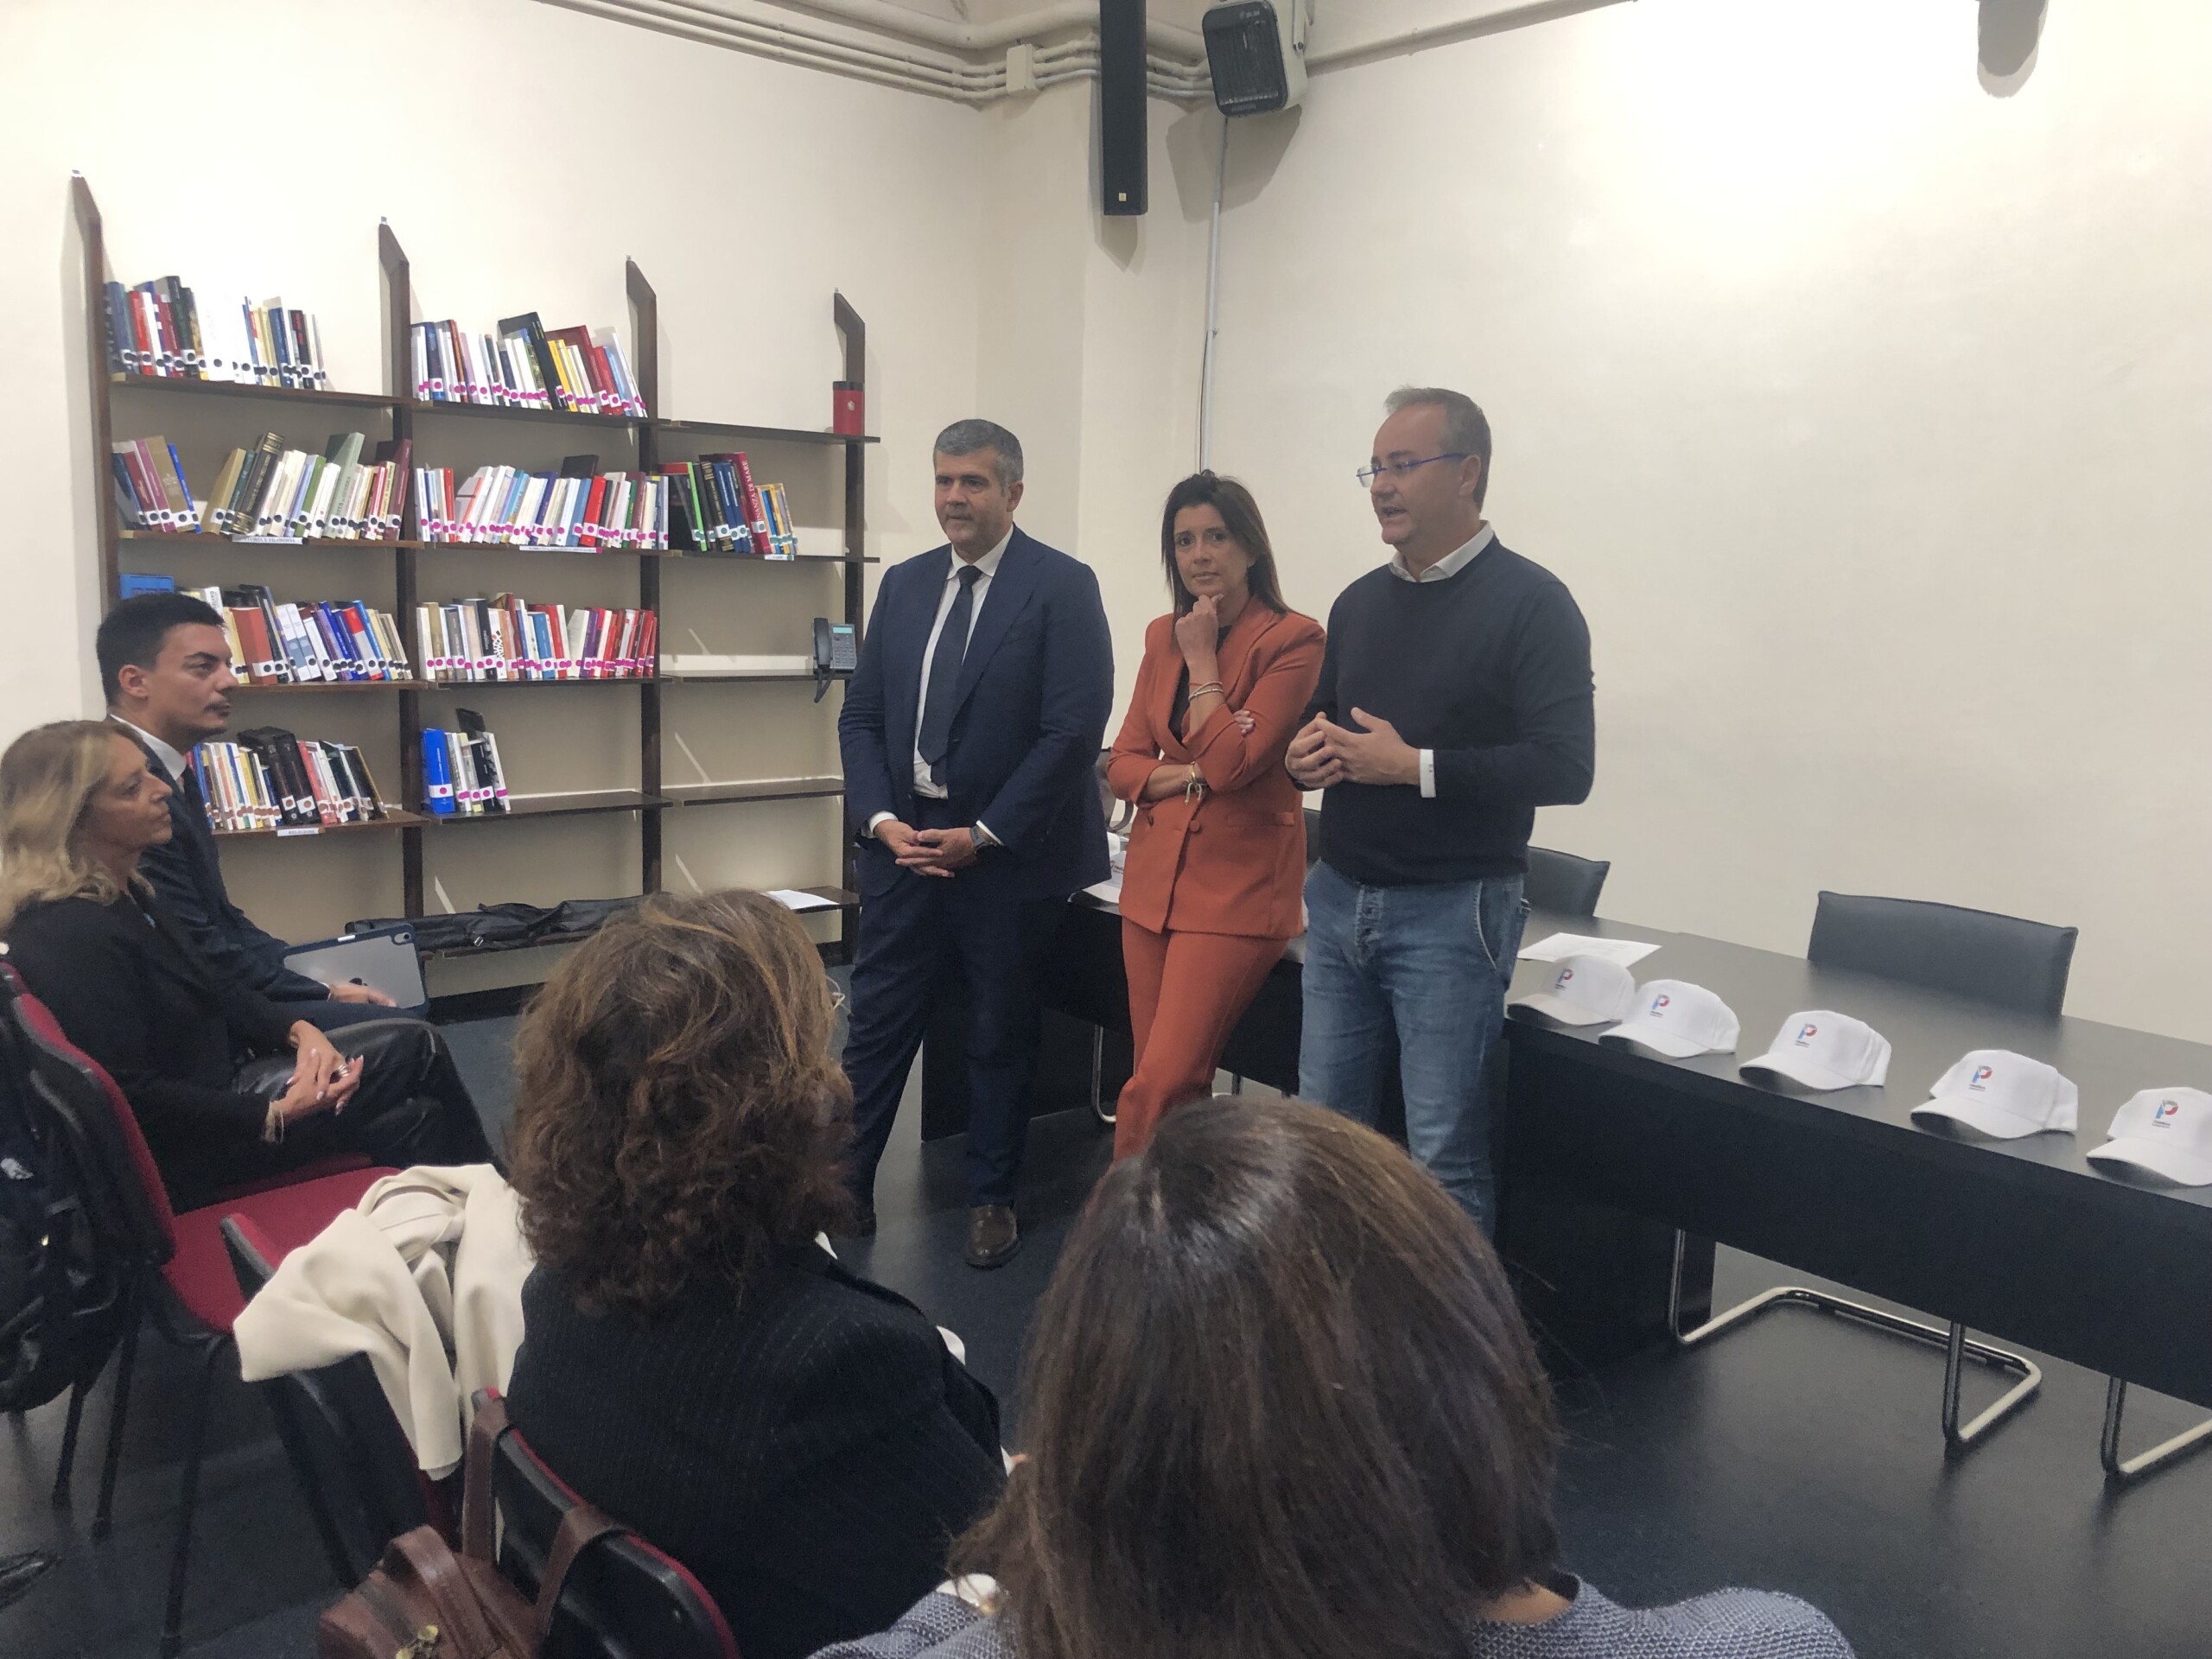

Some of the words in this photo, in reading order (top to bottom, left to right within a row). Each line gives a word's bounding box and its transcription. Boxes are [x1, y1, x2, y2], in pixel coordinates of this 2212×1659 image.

[742, 460, 753, 483] MARE
[1972, 1065, 1993, 1084] P
[2155, 1099, 2179, 1119] P
